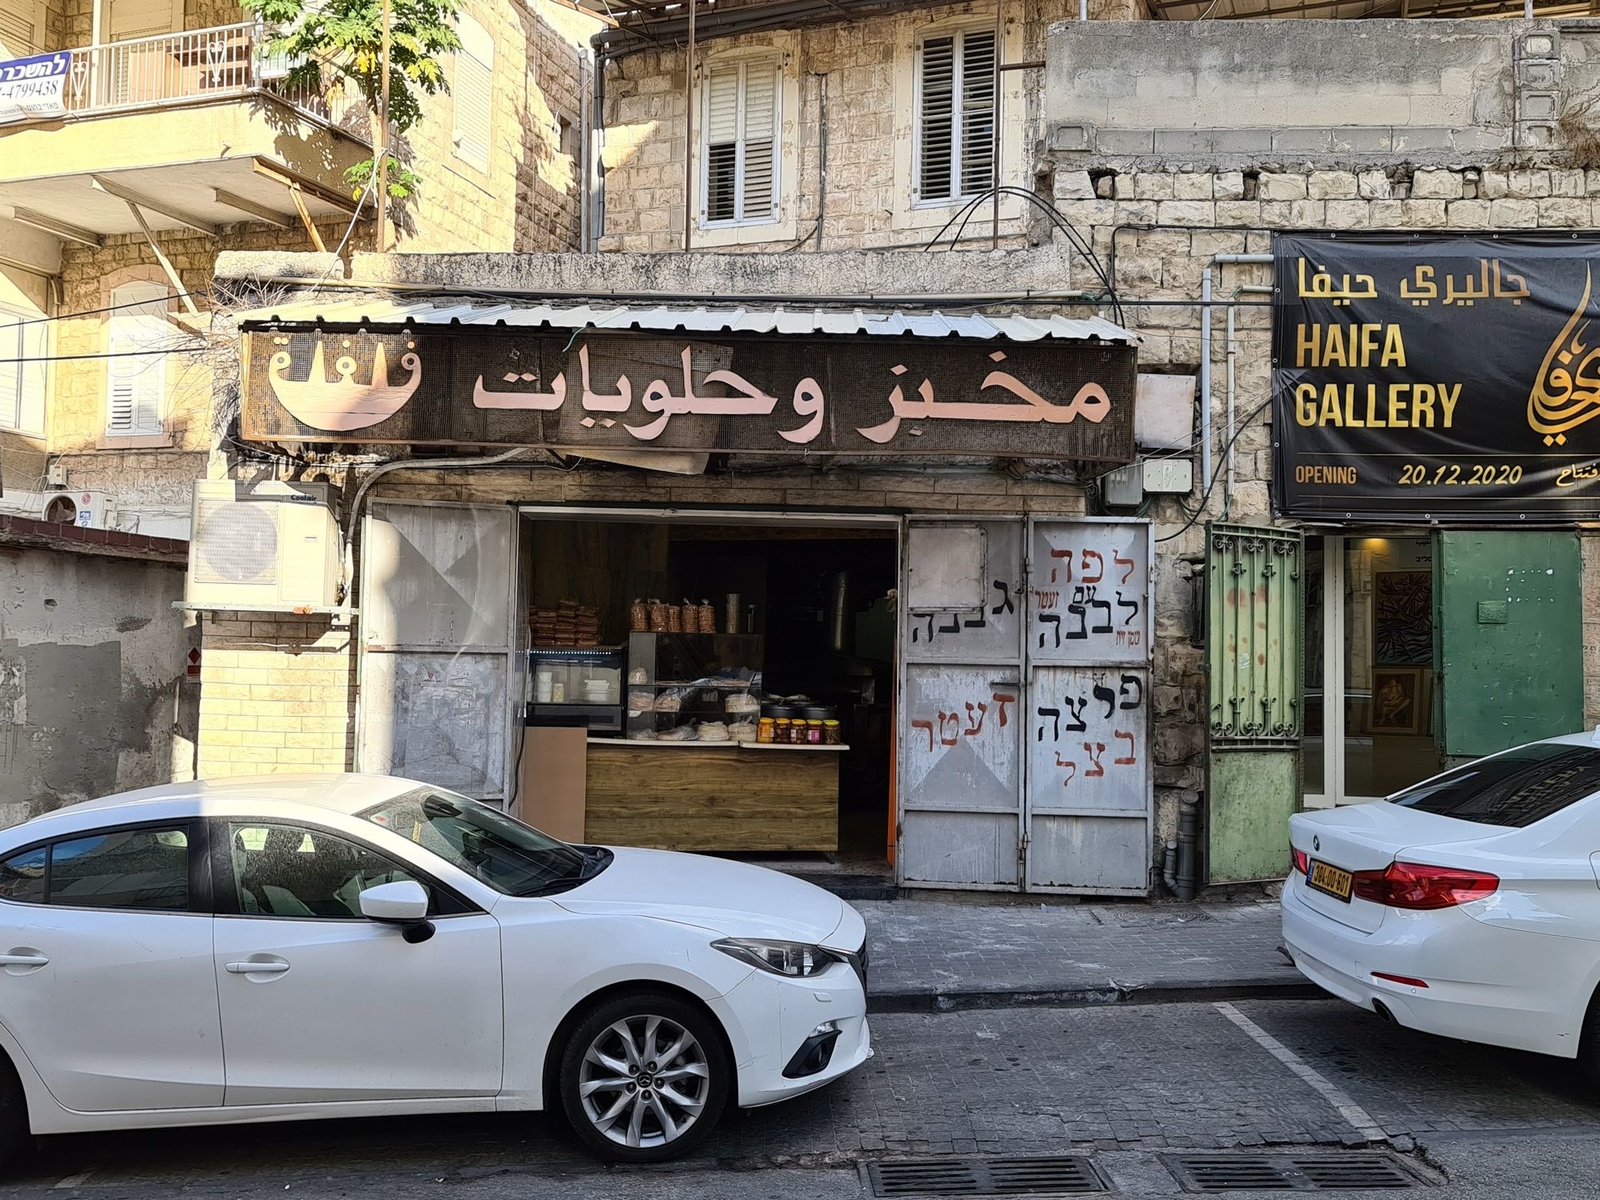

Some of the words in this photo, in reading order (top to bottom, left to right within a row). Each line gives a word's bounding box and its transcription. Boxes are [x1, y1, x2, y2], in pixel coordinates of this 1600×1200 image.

[0, 54, 65, 81] להשכר
[0, 80, 59, 99] -4799438
[1298, 257, 1378, 306] حيفا
[1400, 258, 1531, 306] جاليري
[1295, 323, 1407, 368] HAIFA
[855, 350, 1111, 444] مخبز
[1295, 383, 1463, 428] GALLERY
[1295, 465, 1357, 485] OPENING
[1398, 464, 1523, 486] 20.12.2020
[1556, 462, 1600, 487] فتتاح
[1050, 548, 1135, 584] לפה
[1072, 585, 1097, 604] עם
[1039, 590, 1139, 648] לבנה
[911, 692, 1016, 752] זעטר
[1037, 673, 1143, 742] פיצה
[1054, 729, 1137, 787] בצל
